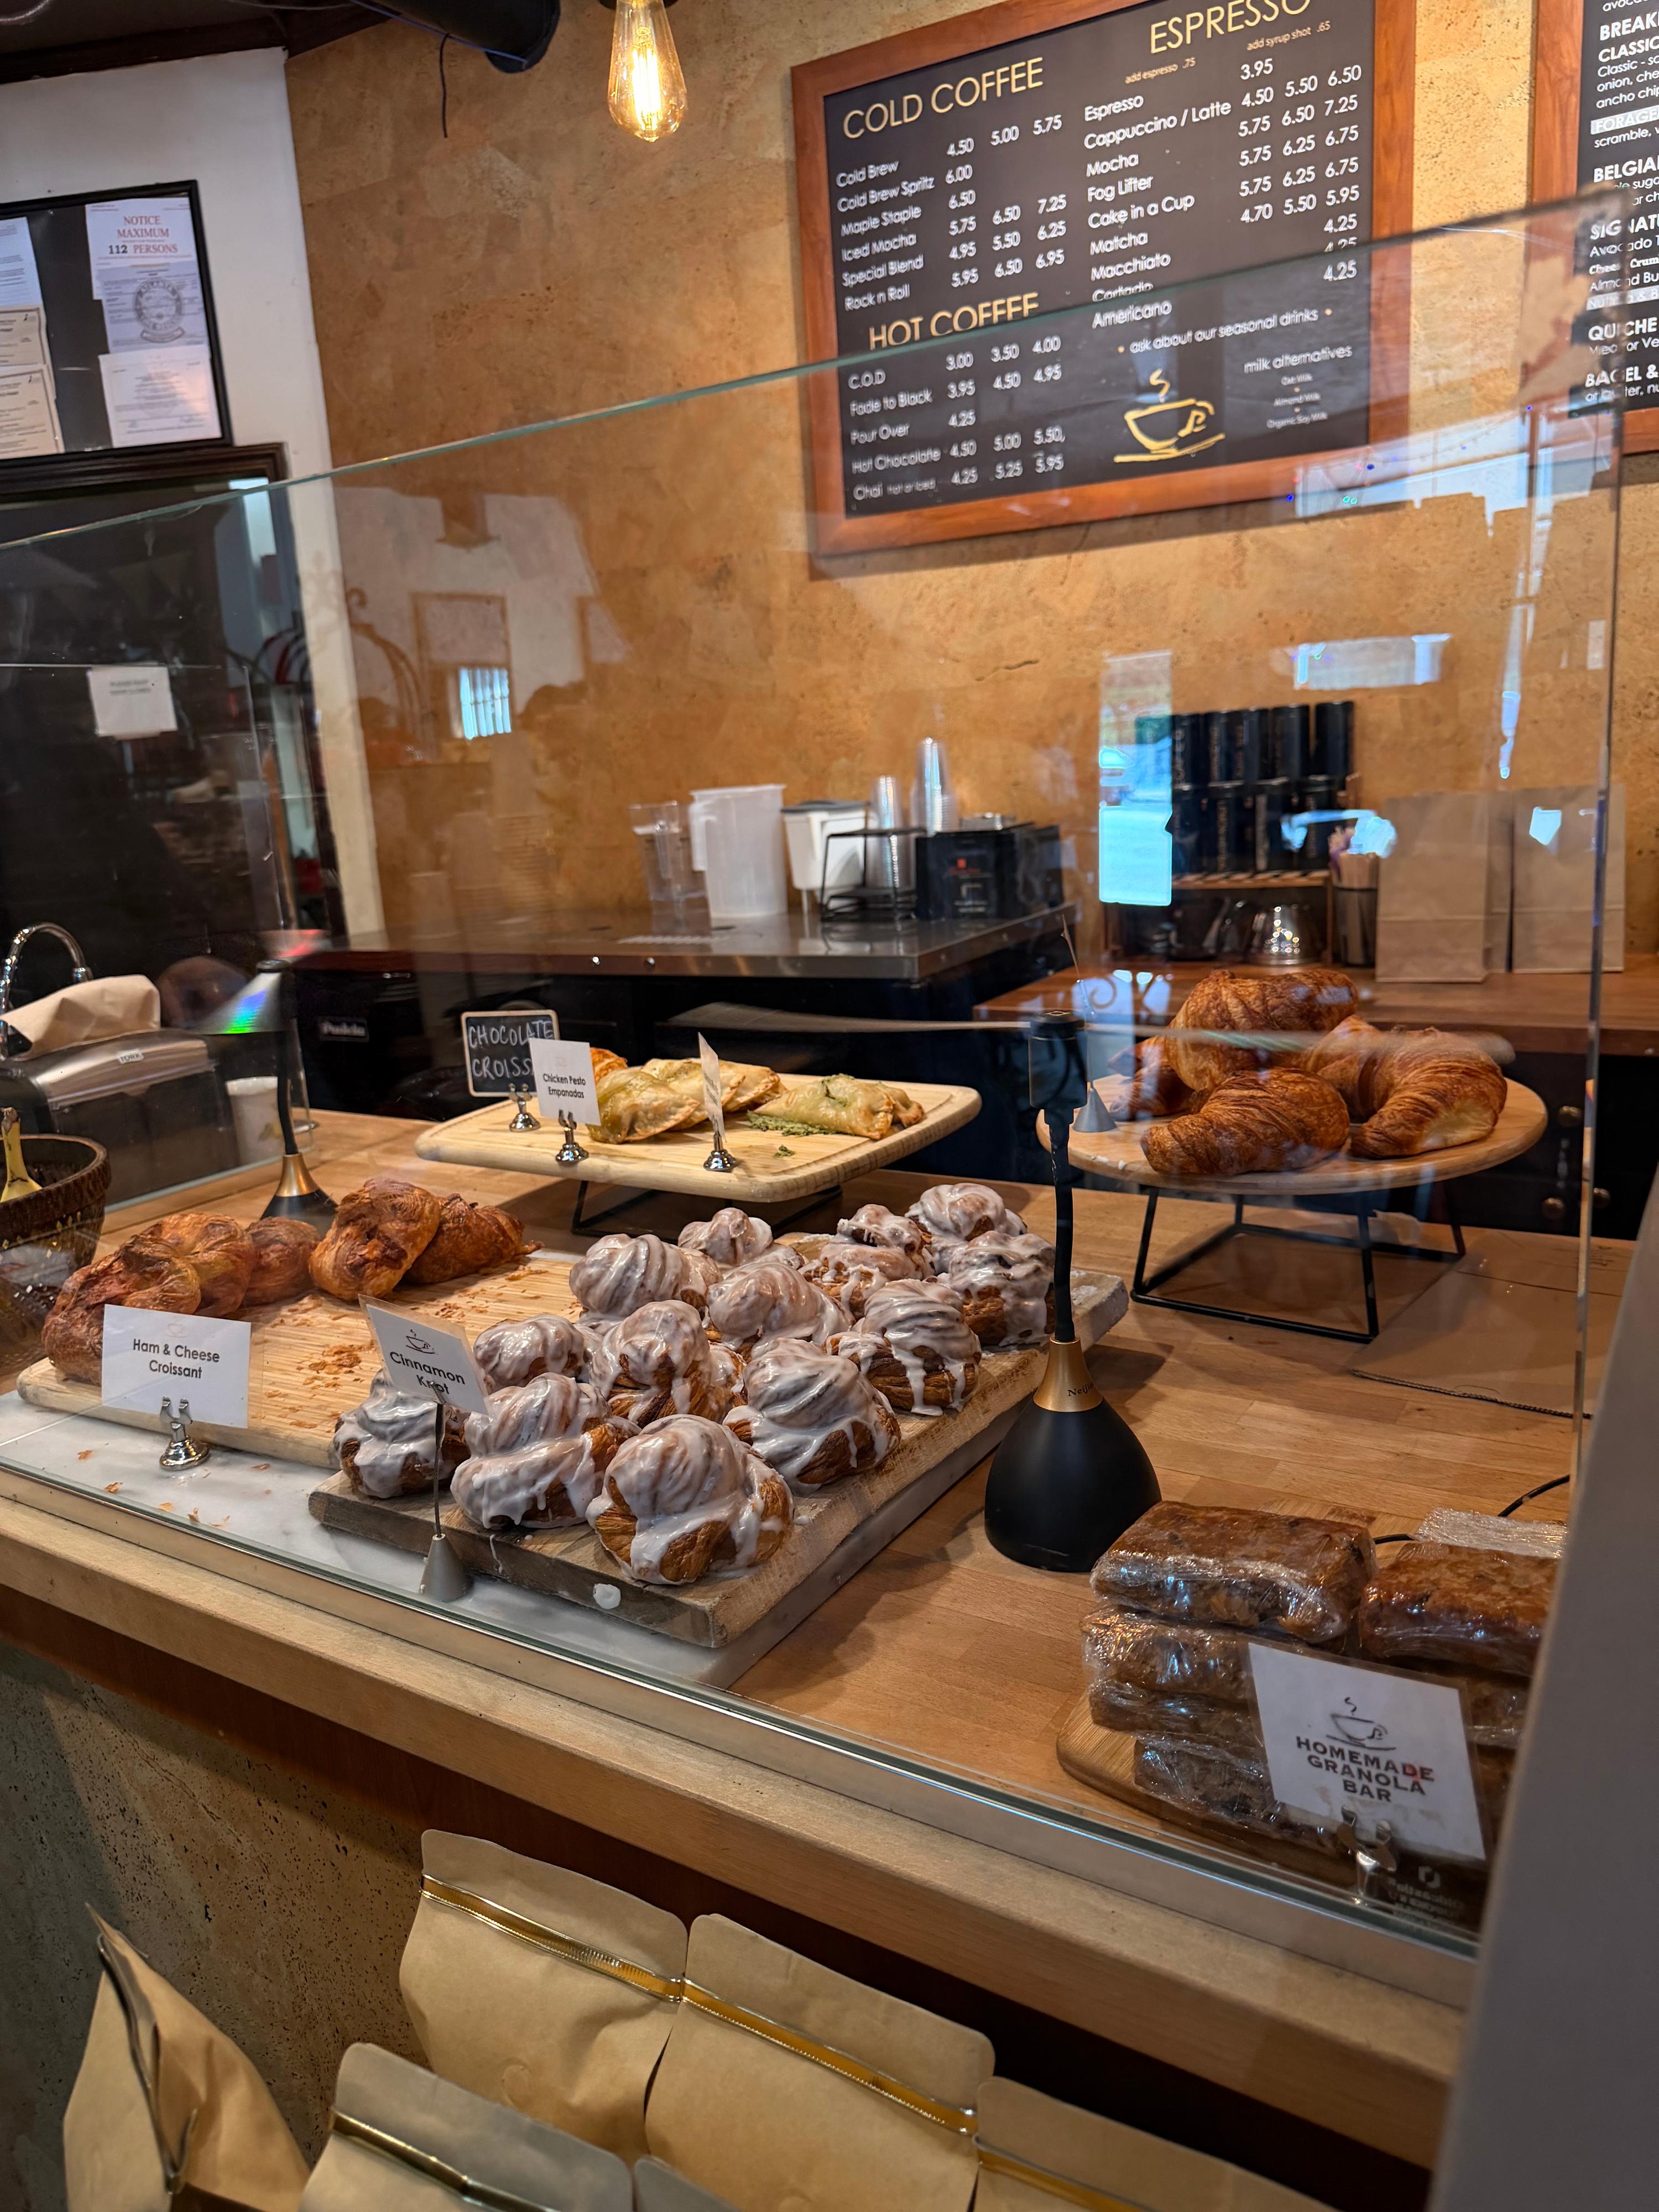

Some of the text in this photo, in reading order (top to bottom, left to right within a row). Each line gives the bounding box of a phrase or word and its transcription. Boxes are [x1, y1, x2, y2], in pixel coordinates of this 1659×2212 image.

[1603, 0, 1648, 12] avoc
[1246, 21, 1331, 50] add syrup shot .65
[1600, 11, 1659, 40] BREAK
[1125, 71, 1141, 84] add
[1142, 64, 1178, 80] espresso
[1597, 77, 1633, 92] onion,
[1598, 60, 1637, 77] Classic
[843, 57, 1043, 138] COLD COFFEE
[1084, 59, 1273, 121] Espresso 3.95
[1596, 92, 1635, 108] ancho
[1084, 65, 1361, 149] Cappuccino / Latte 4.50 5.50 6.50
[1595, 108, 1659, 133] FORAGE
[836, 115, 1062, 187] Cold Brew 4.50 5.00 5.75
[1087, 95, 1358, 176] Mocha 5.75 6.50 7.25
[1088, 183, 1114, 204] Fog
[1239, 145, 1272, 166] 5.75
[1282, 135, 1316, 156] 6.25
[1325, 126, 1359, 148] 6.75
[1594, 155, 1659, 182] BELGIA
[837, 165, 973, 212] Cold Brew Spritz 6.00
[1131, 205, 1144, 220] in
[1147, 204, 1159, 216] a
[1161, 195, 1194, 213] Cup
[1239, 176, 1272, 197] 5.75
[1282, 166, 1316, 187] 6.25
[1325, 156, 1359, 179] 6.75
[123, 215, 161, 225] NOTICE
[841, 190, 975, 236] Maple Staple 6.50
[841, 195, 1067, 262] Iced Mocha 5.75 6.50 7.25
[1089, 185, 1360, 255] Matcha 4.70 5.50 5.95
[1590, 213, 1659, 240] SIGAT
[108, 244, 178, 254] 112 PERSONS
[117, 228, 169, 238] MAXIMUM
[1091, 213, 1358, 281] Macchiato 4.25
[841, 221, 1066, 288] Special Blend 4.95 5.50 6.25
[1092, 236, 1358, 302] Cortado 425
[844, 249, 1065, 311] Rock n Roll 5.95 6.50 6.95
[1092, 259, 1357, 329] Americano 4.25
[869, 316, 924, 350] HOT
[1130, 308, 1319, 353] ask about our seasonal drinks
[1588, 317, 1657, 341] QUICHE
[946, 351, 974, 371] 3.00
[991, 343, 1020, 362] 3.50
[1032, 335, 1061, 354] 4.00
[1244, 346, 1353, 373] milk alternatives
[1626, 341, 1640, 352] or
[1646, 364, 1658, 379] &
[850, 363, 1062, 416] Fade to Black 3.95 4.50 4.95
[851, 409, 976, 445] Pour Over 4.25
[852, 457, 873, 474] Hot
[874, 447, 941, 470] Chocolate
[950, 439, 977, 458] 4.50
[993, 432, 1021, 451] 5.00
[853, 480, 883, 500] Chai
[951, 467, 978, 485] 4.25
[995, 460, 1023, 479] 5.25
[1035, 453, 1064, 473] 5.95
[468, 1020, 554, 1048] CHOCOLATE
[472, 1056, 534, 1080] CROISS
[543, 1073, 586, 1086] Chicken Pesto
[548, 1087, 585, 1099] Empanadas
[133, 1338, 220, 1363] Ham & Cheese
[149, 1359, 202, 1379] Croissant
[390, 1352, 466, 1385] Cinnamon
[1296, 1736, 1434, 1782] HOMEMADE
[1307, 1755, 1426, 1796] GRANOLA
[1343, 1779, 1391, 1802] BAR
